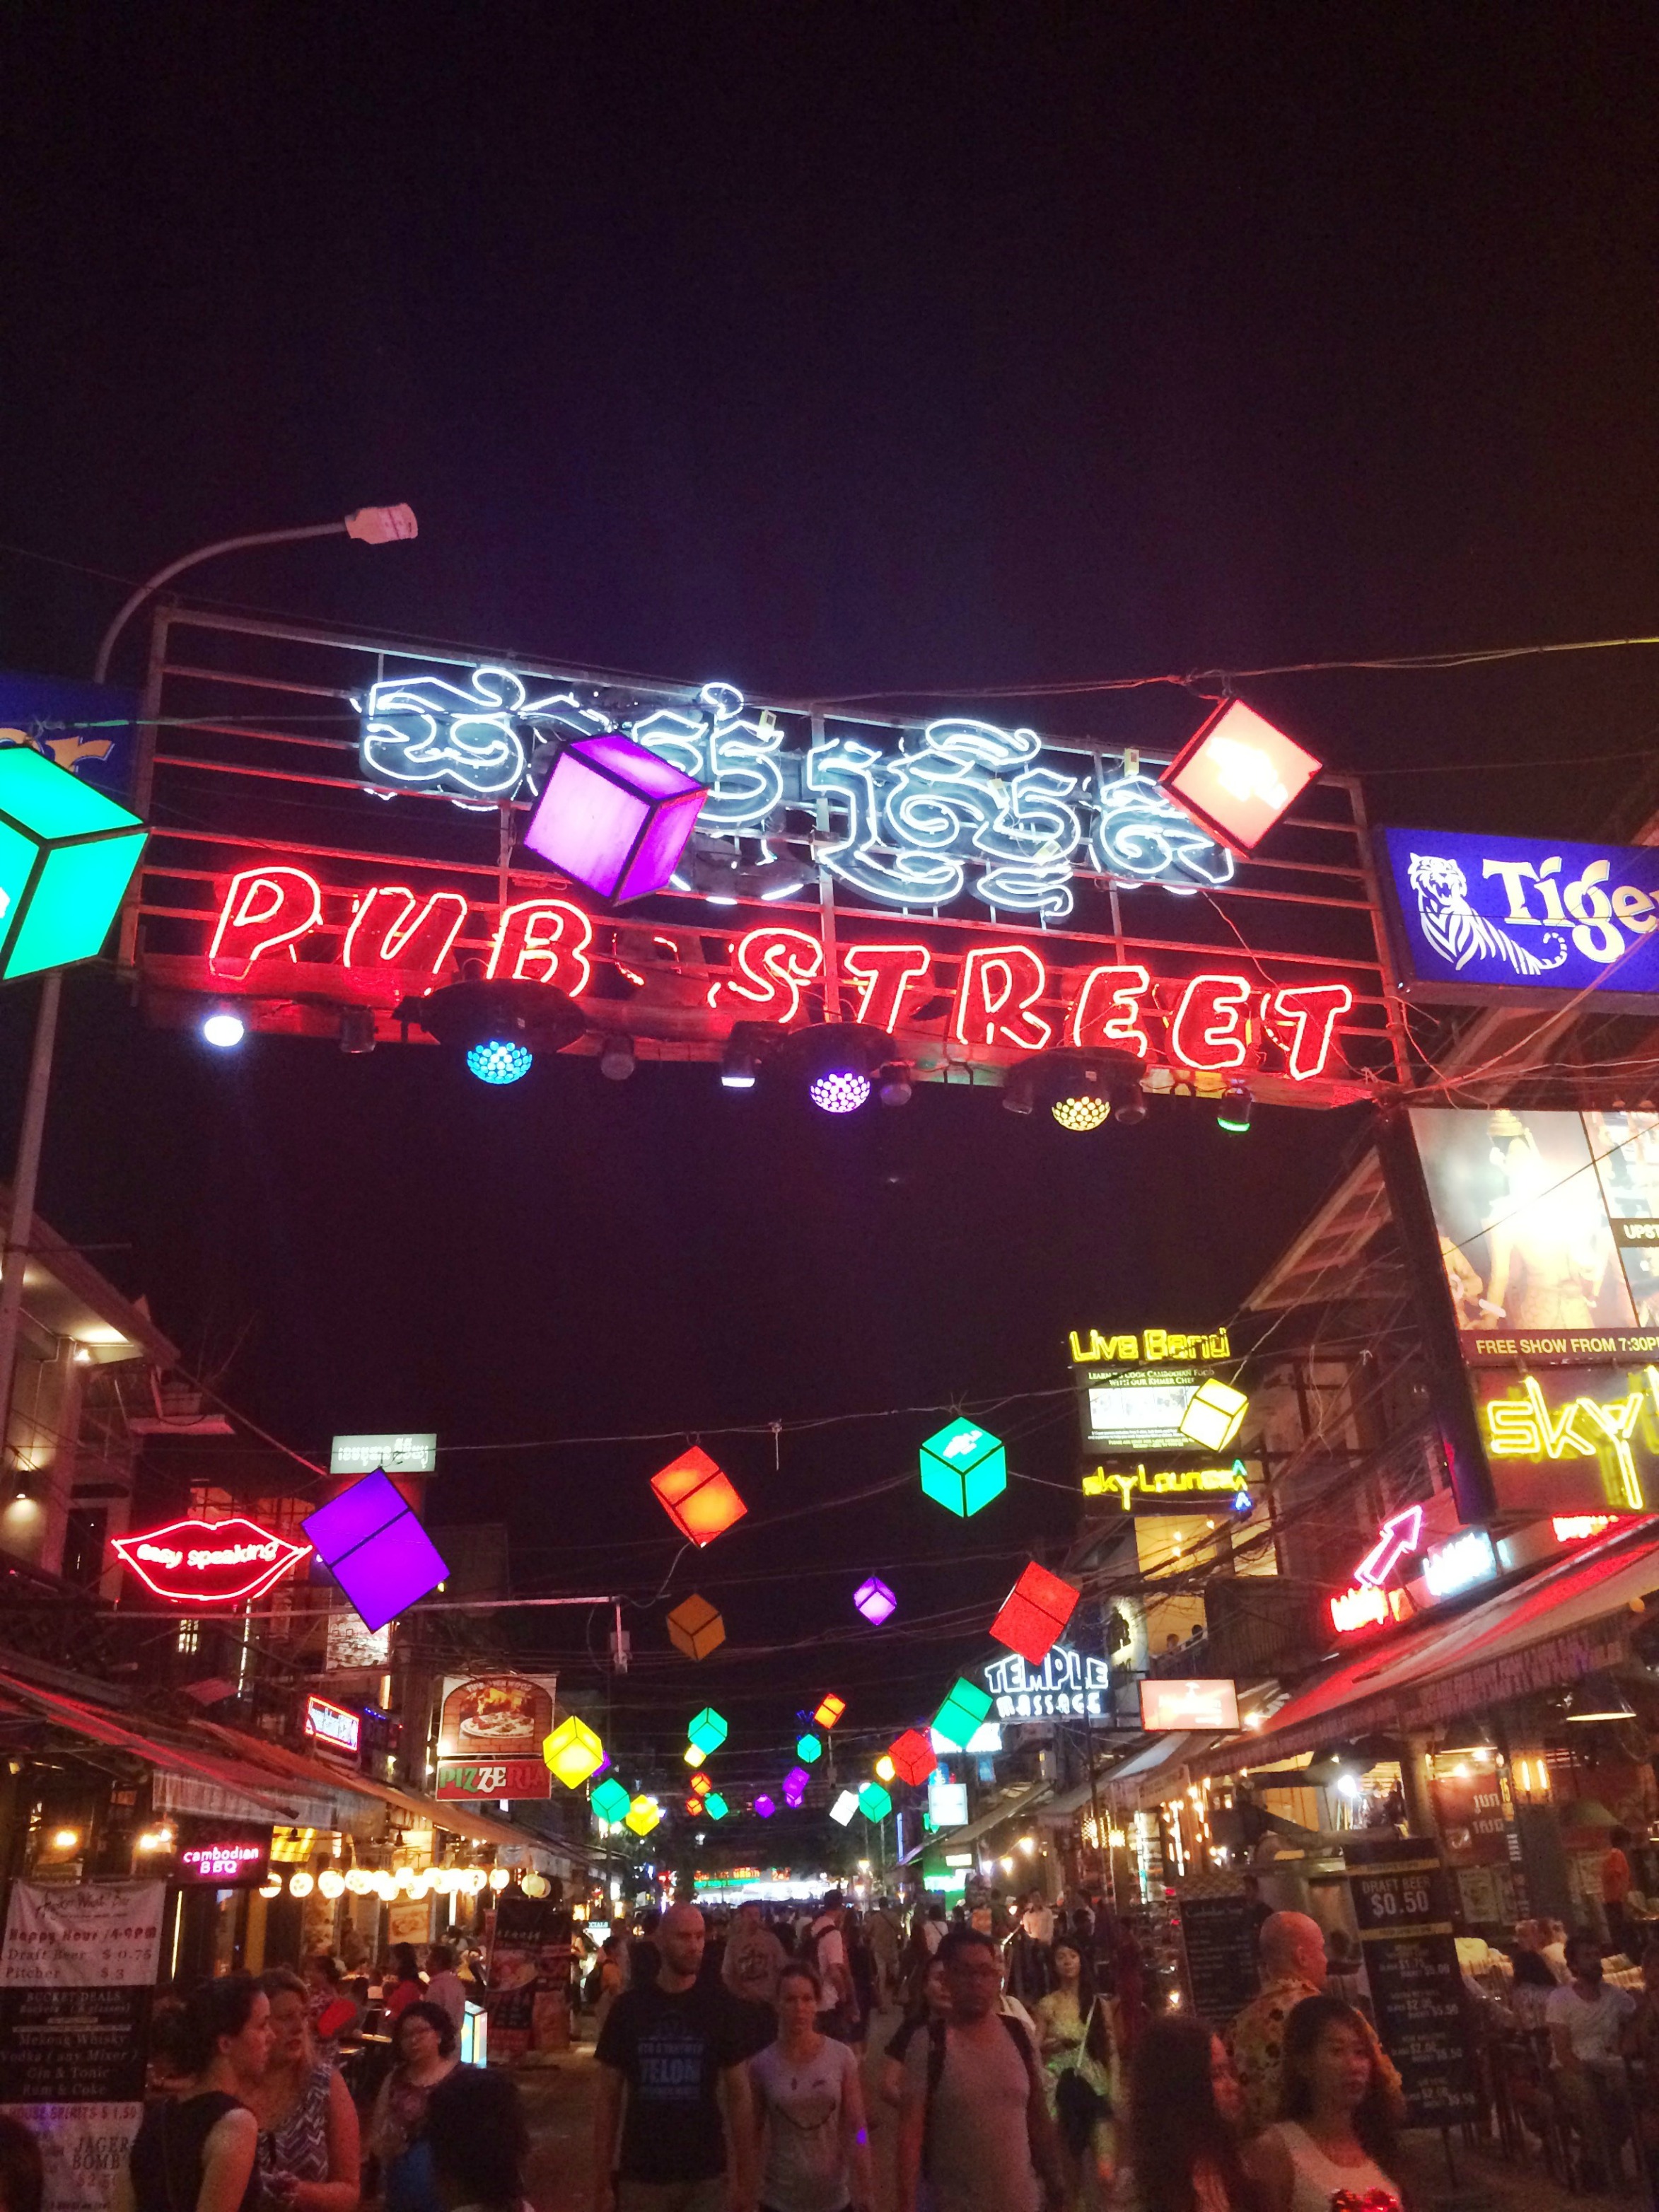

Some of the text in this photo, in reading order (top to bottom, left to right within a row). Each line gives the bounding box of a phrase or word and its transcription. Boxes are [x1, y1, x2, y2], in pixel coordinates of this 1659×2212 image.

[1482, 856, 1659, 963] Tige
[208, 866, 1354, 1081] PUB STREET
[1476, 1337, 1659, 1355] FREE SHOW FROM 7:30P
[984, 1644, 1109, 1694] TEMPLE
[996, 1692, 1102, 1718] MASSAGE
[439, 1766, 548, 1793] PIZZERIA
[200, 1860, 237, 1874] BBQ
[1361, 1875, 1431, 1894] DRAFT BEER
[1370, 1890, 1430, 1919] $0.50
